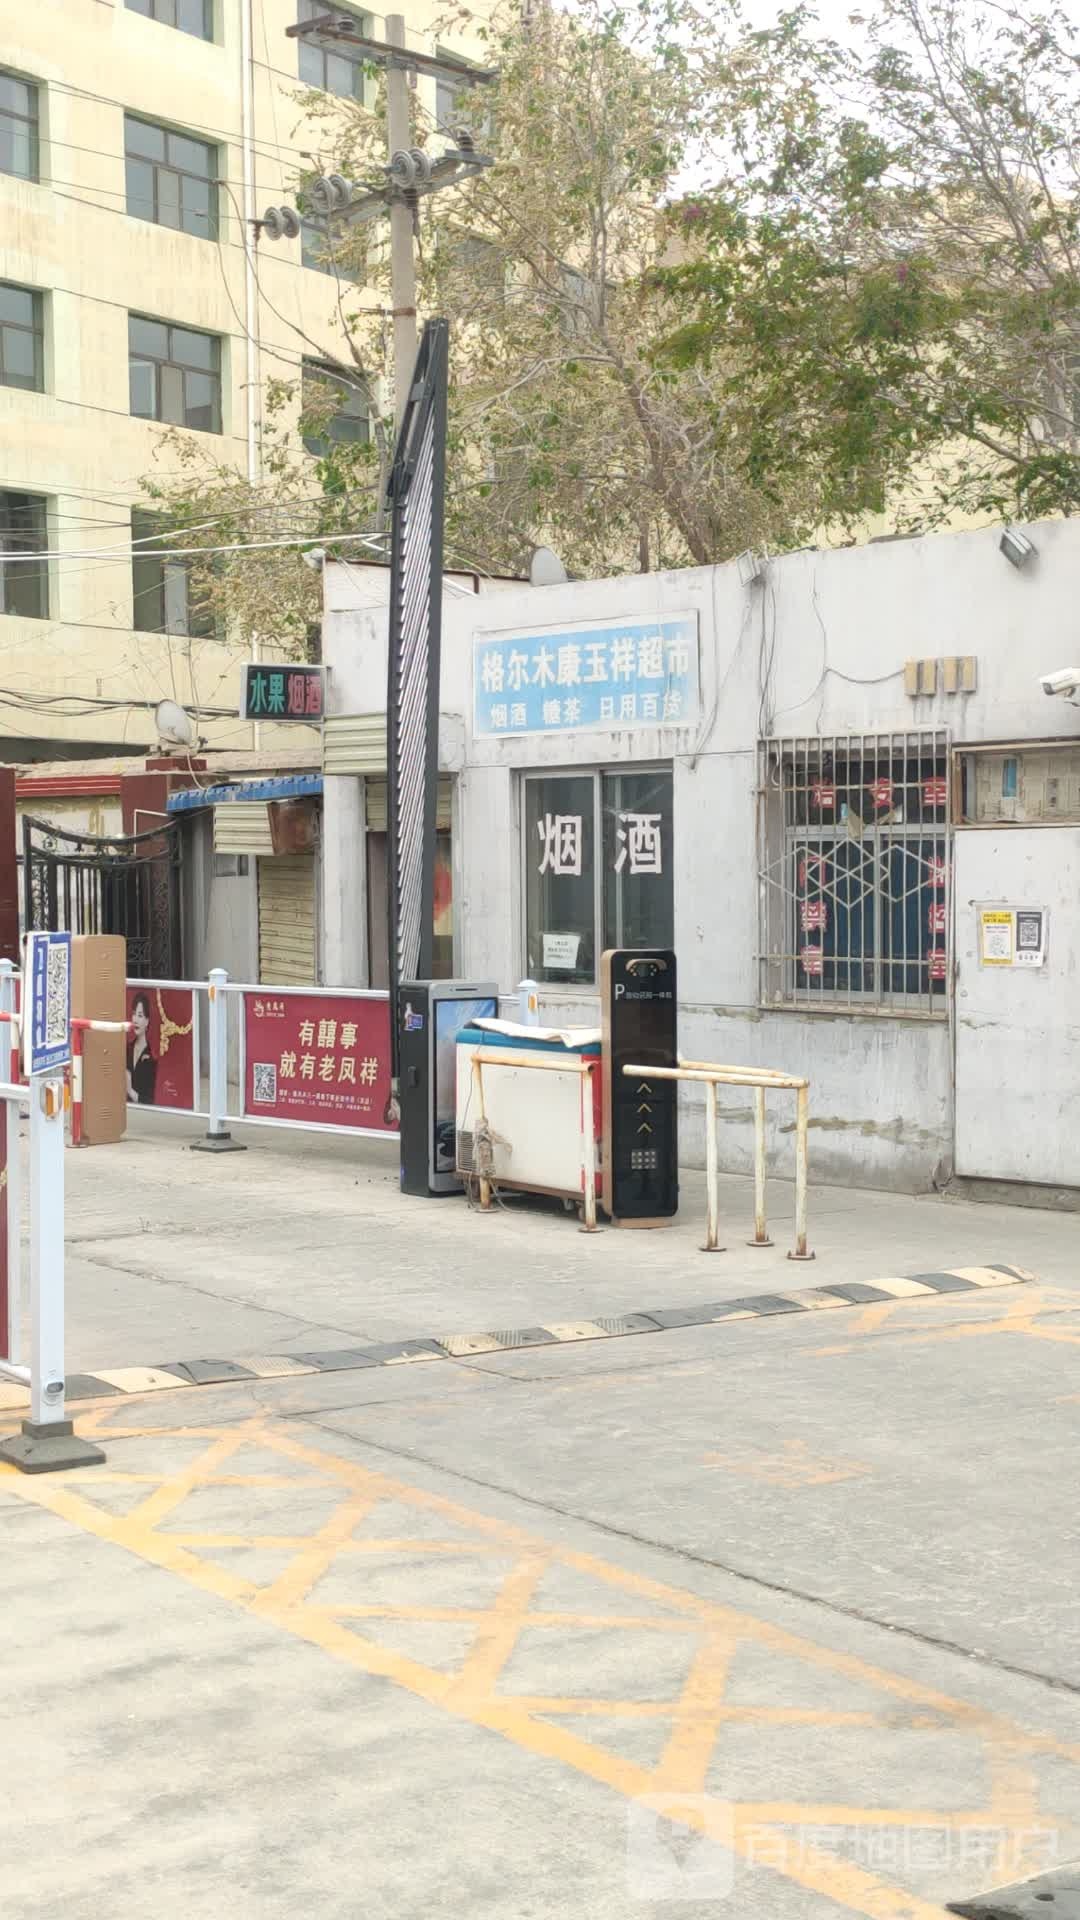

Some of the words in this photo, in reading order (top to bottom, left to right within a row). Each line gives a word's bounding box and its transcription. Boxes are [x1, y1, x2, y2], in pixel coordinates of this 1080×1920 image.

[249, 671, 321, 714] 水果烟酒
[490, 702, 527, 729] 烟酒
[600, 690, 681, 722] 日用百货
[615, 983, 625, 1001] P
[280, 1050, 378, 1087] 就有老凤祥
